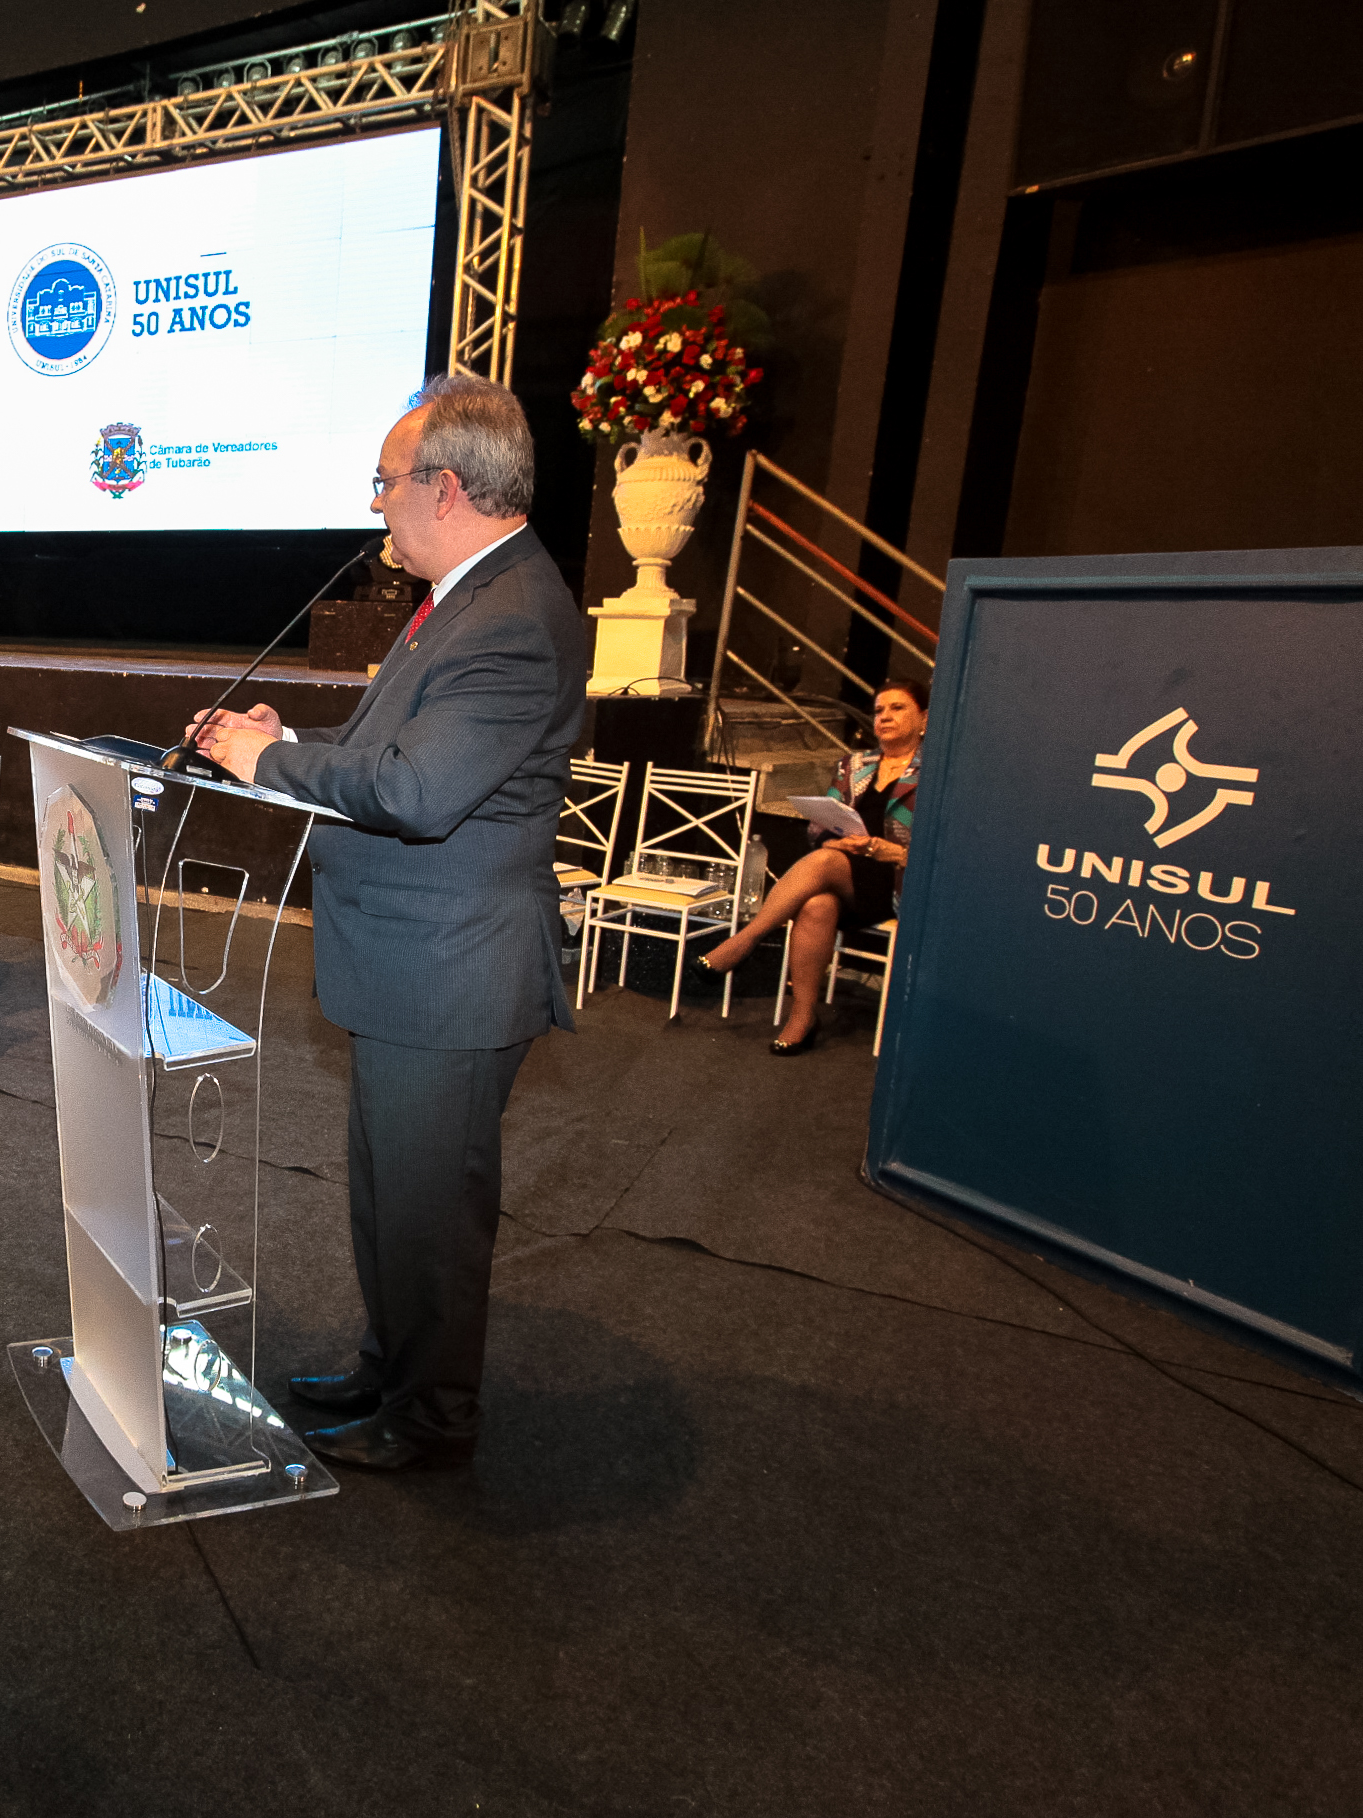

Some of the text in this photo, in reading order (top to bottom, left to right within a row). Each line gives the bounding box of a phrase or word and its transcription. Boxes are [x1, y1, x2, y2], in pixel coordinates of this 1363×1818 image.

[51, 248, 66, 257] SUL
[68, 247, 80, 257] DE
[81, 250, 104, 275] SANTA
[101, 274, 113, 324] CATARINA
[133, 269, 239, 305] UNISUL
[132, 301, 251, 337] 50 ANOS
[149, 440, 278, 456] Câmara de Vereadores
[149, 457, 211, 469] de Tubarão
[1036, 843, 1296, 916] UNISUL
[1044, 883, 1262, 960] 50 ANOS
